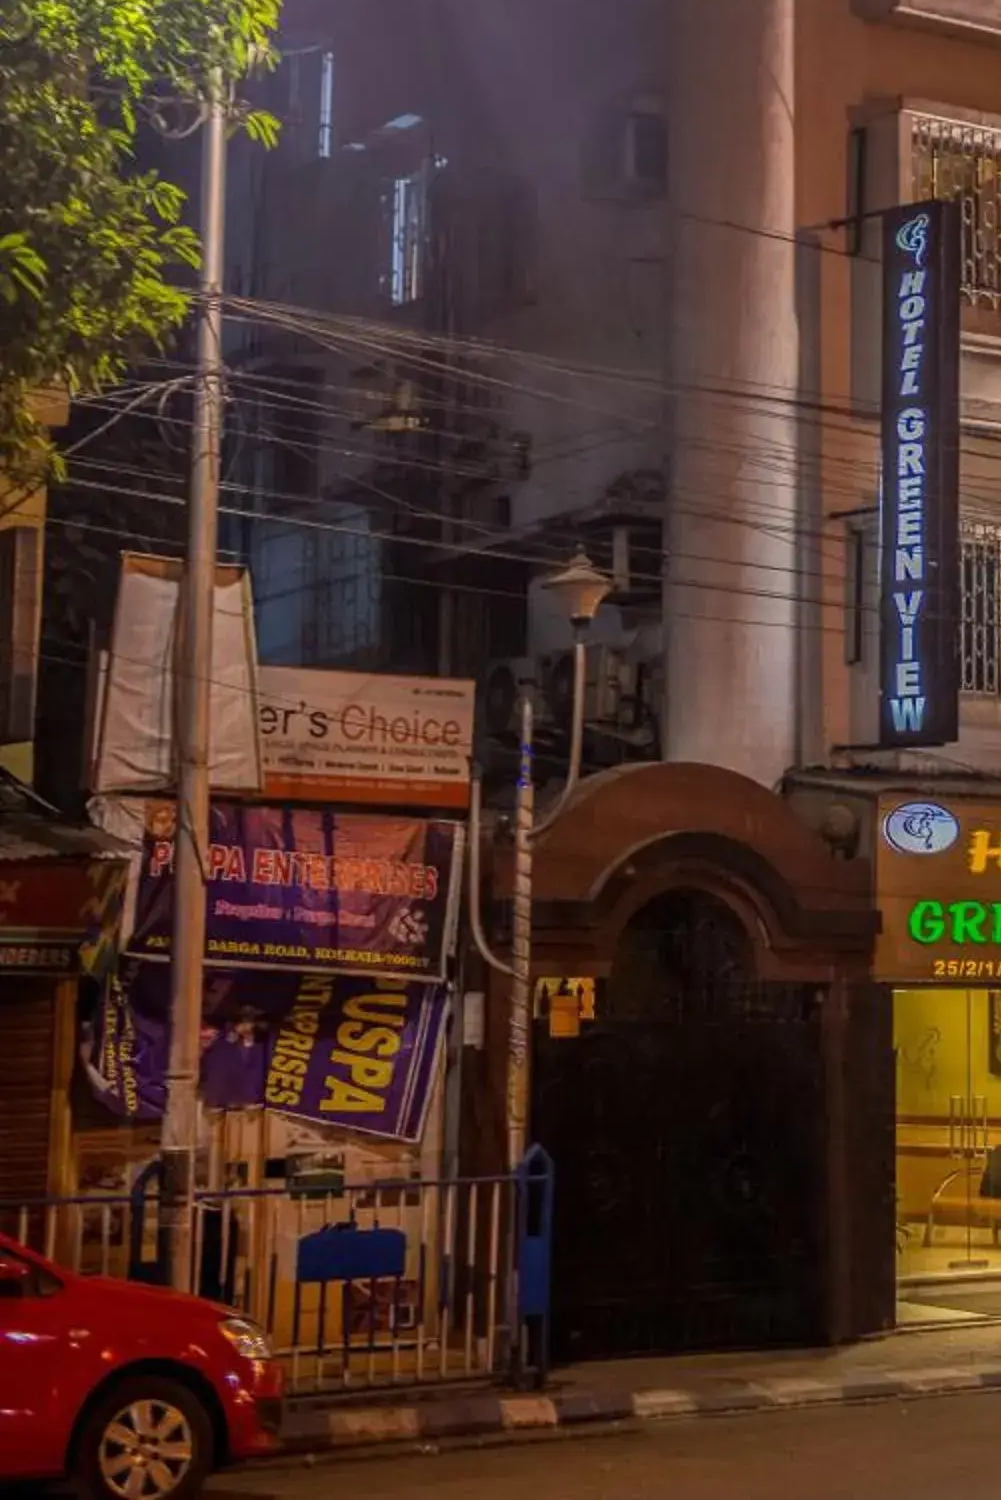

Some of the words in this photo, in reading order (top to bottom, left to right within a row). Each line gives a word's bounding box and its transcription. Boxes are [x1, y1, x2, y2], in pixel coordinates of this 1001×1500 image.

[898, 268, 927, 397] HOTEL
[894, 407, 928, 582] GREEN
[890, 589, 926, 733] VIEW
[339, 704, 462, 748] Choice
[149, 840, 247, 884] PPA
[252, 848, 439, 901] ENTERPRISES
[208, 940, 261, 957] DARGA
